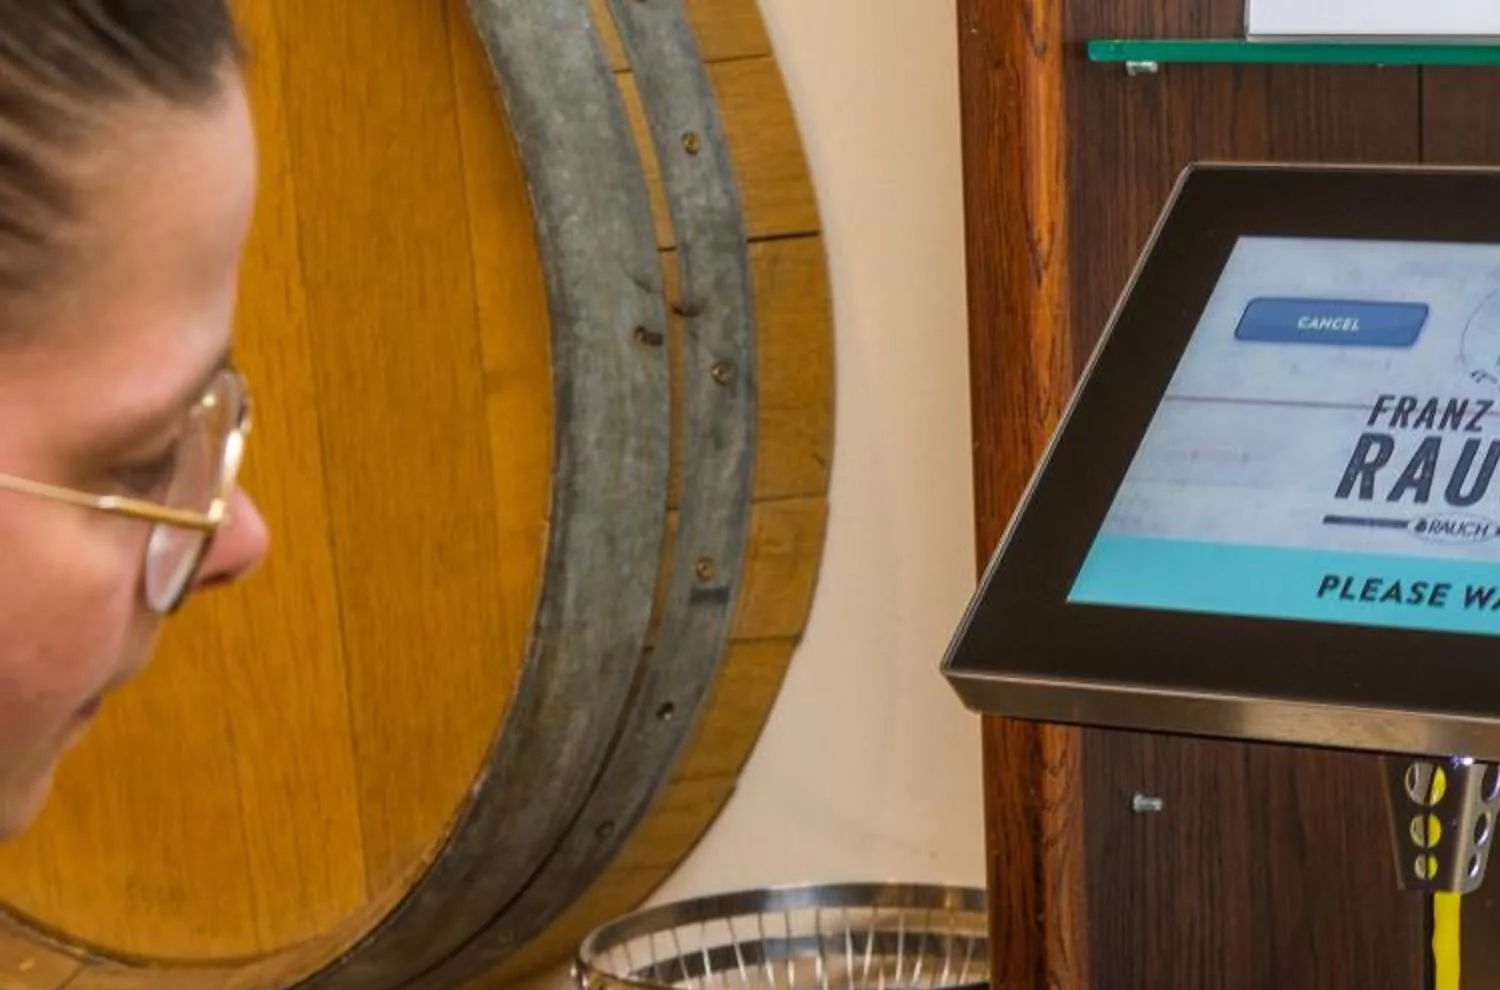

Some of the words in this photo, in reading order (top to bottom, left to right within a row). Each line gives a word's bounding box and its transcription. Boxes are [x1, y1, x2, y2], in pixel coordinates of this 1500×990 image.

[1297, 316, 1360, 332] CANCEL
[1367, 394, 1495, 433] FRANZ
[1427, 518, 1490, 537] RAUCH
[1316, 574, 1453, 608] PLEASE
